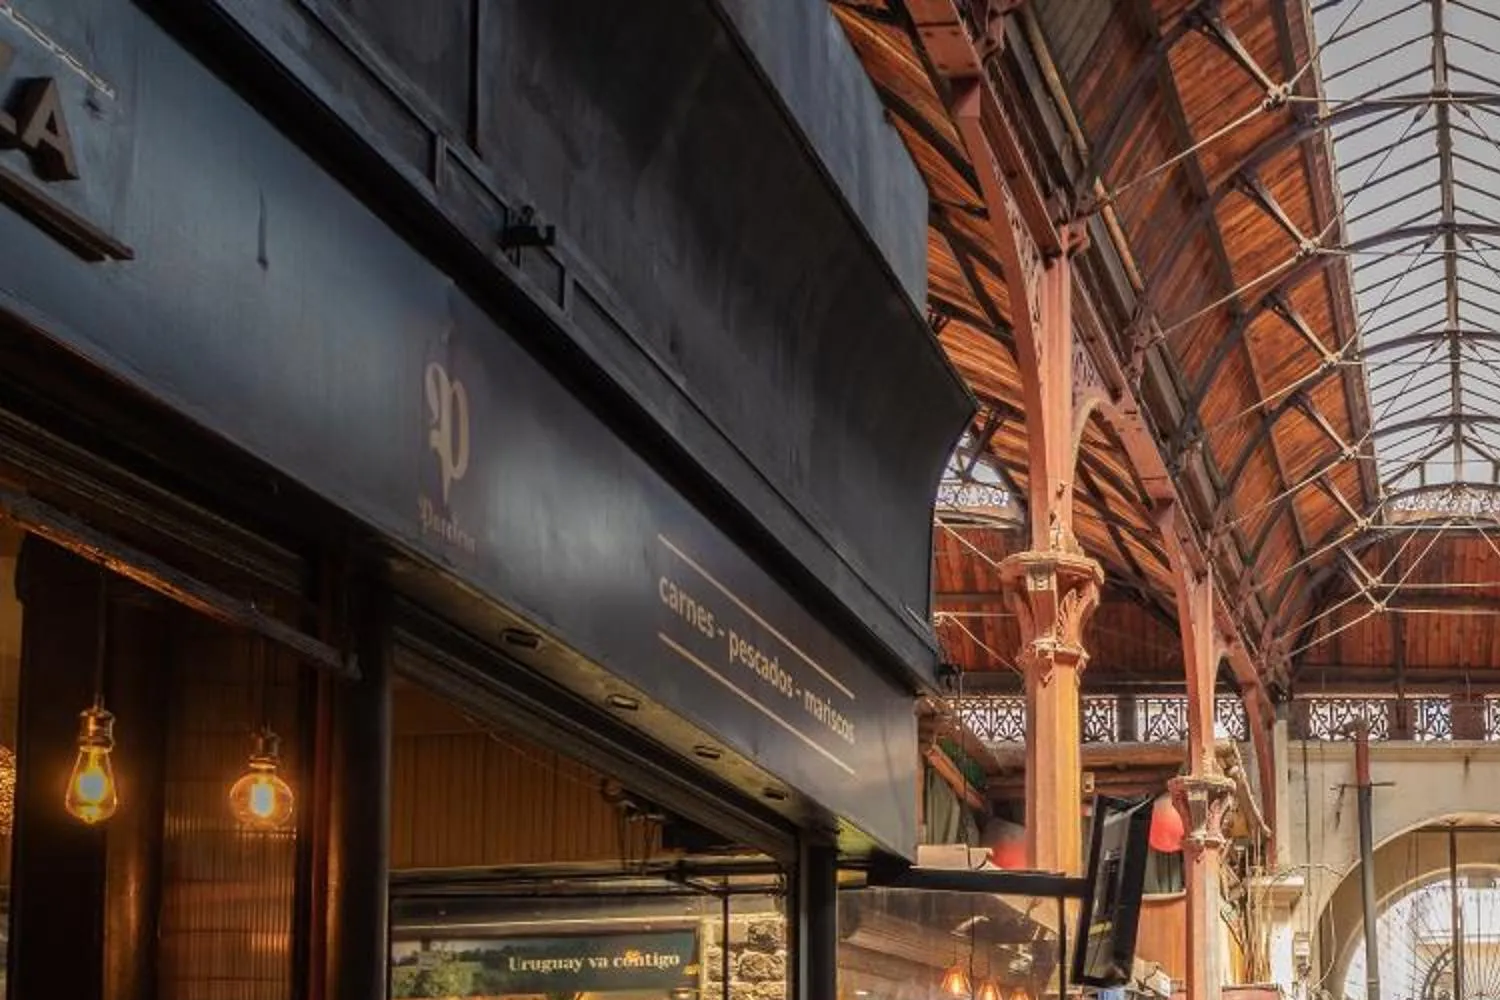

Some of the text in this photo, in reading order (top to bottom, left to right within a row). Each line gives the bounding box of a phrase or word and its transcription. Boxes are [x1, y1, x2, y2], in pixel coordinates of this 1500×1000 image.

[659, 575, 715, 639] carnes
[729, 627, 794, 699] pescados
[804, 688, 856, 744] mariscos
[508, 952, 681, 975] Uruguay va contigo
